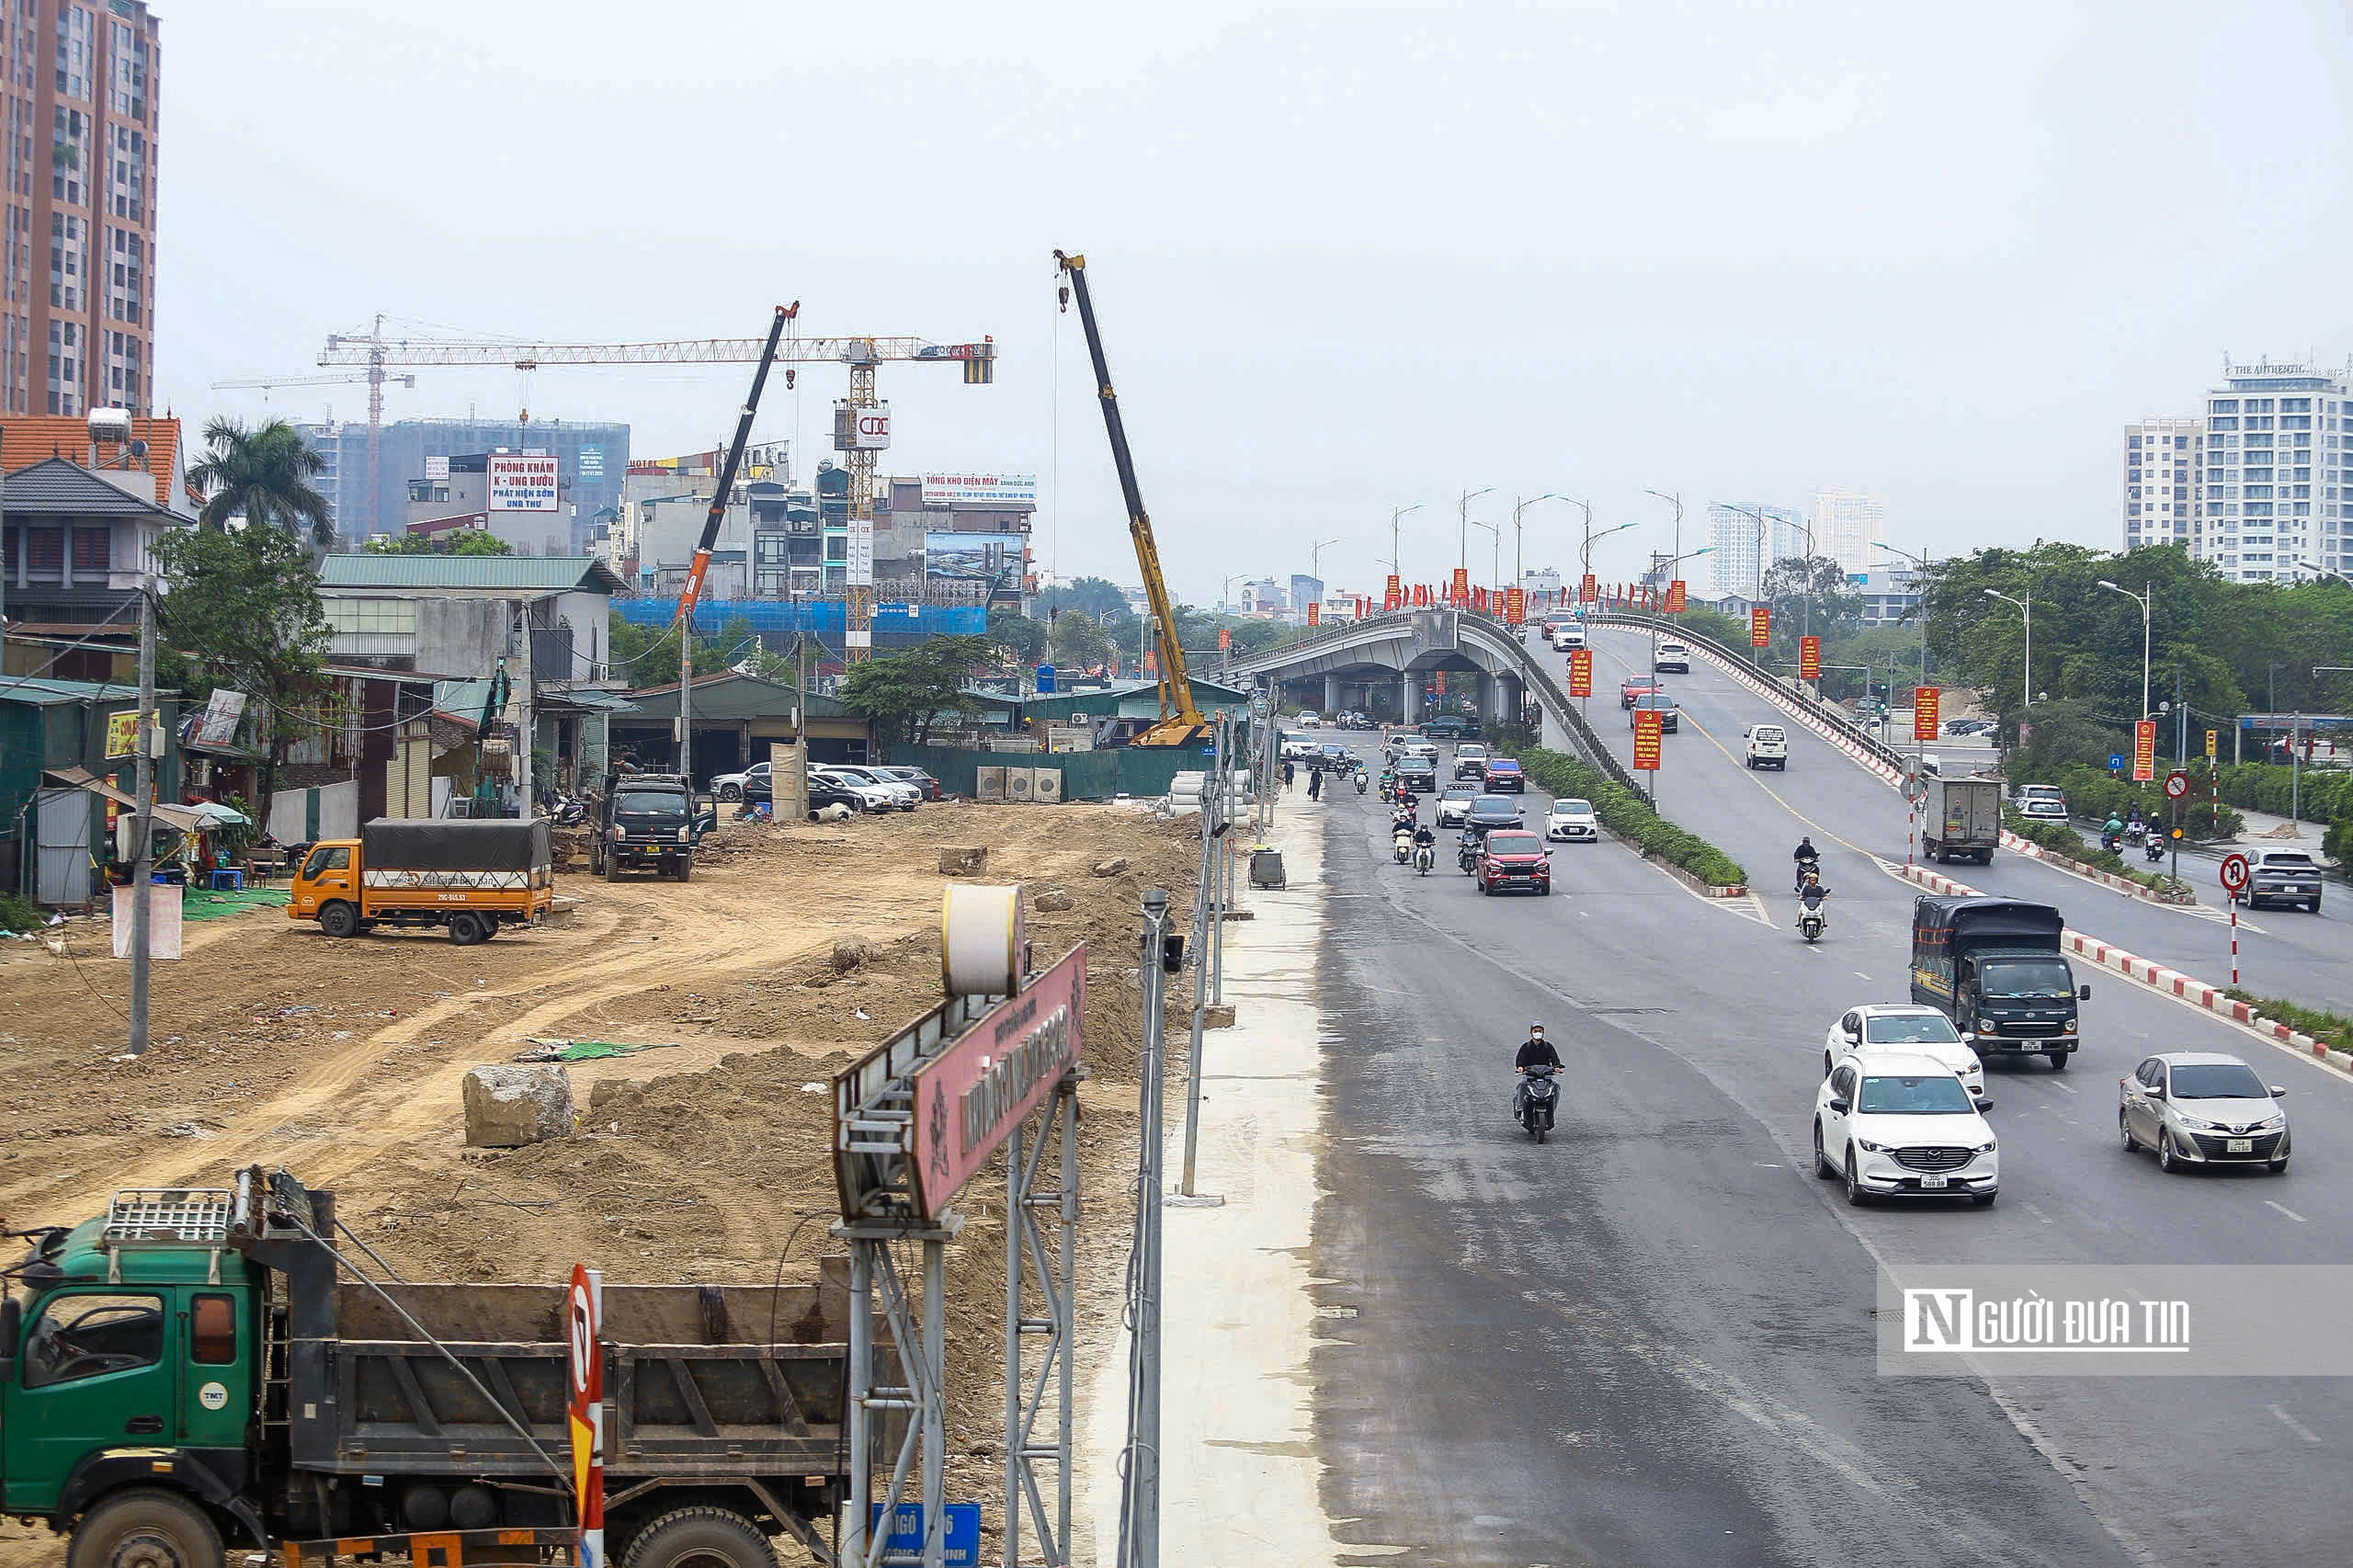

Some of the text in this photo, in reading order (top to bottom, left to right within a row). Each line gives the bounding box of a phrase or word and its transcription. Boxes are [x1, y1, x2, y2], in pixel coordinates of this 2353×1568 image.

[527, 460, 554, 472] KHÁM
[494, 476, 501, 486] K
[947, 476, 961, 485] KHO
[982, 475, 999, 485] MÁY
